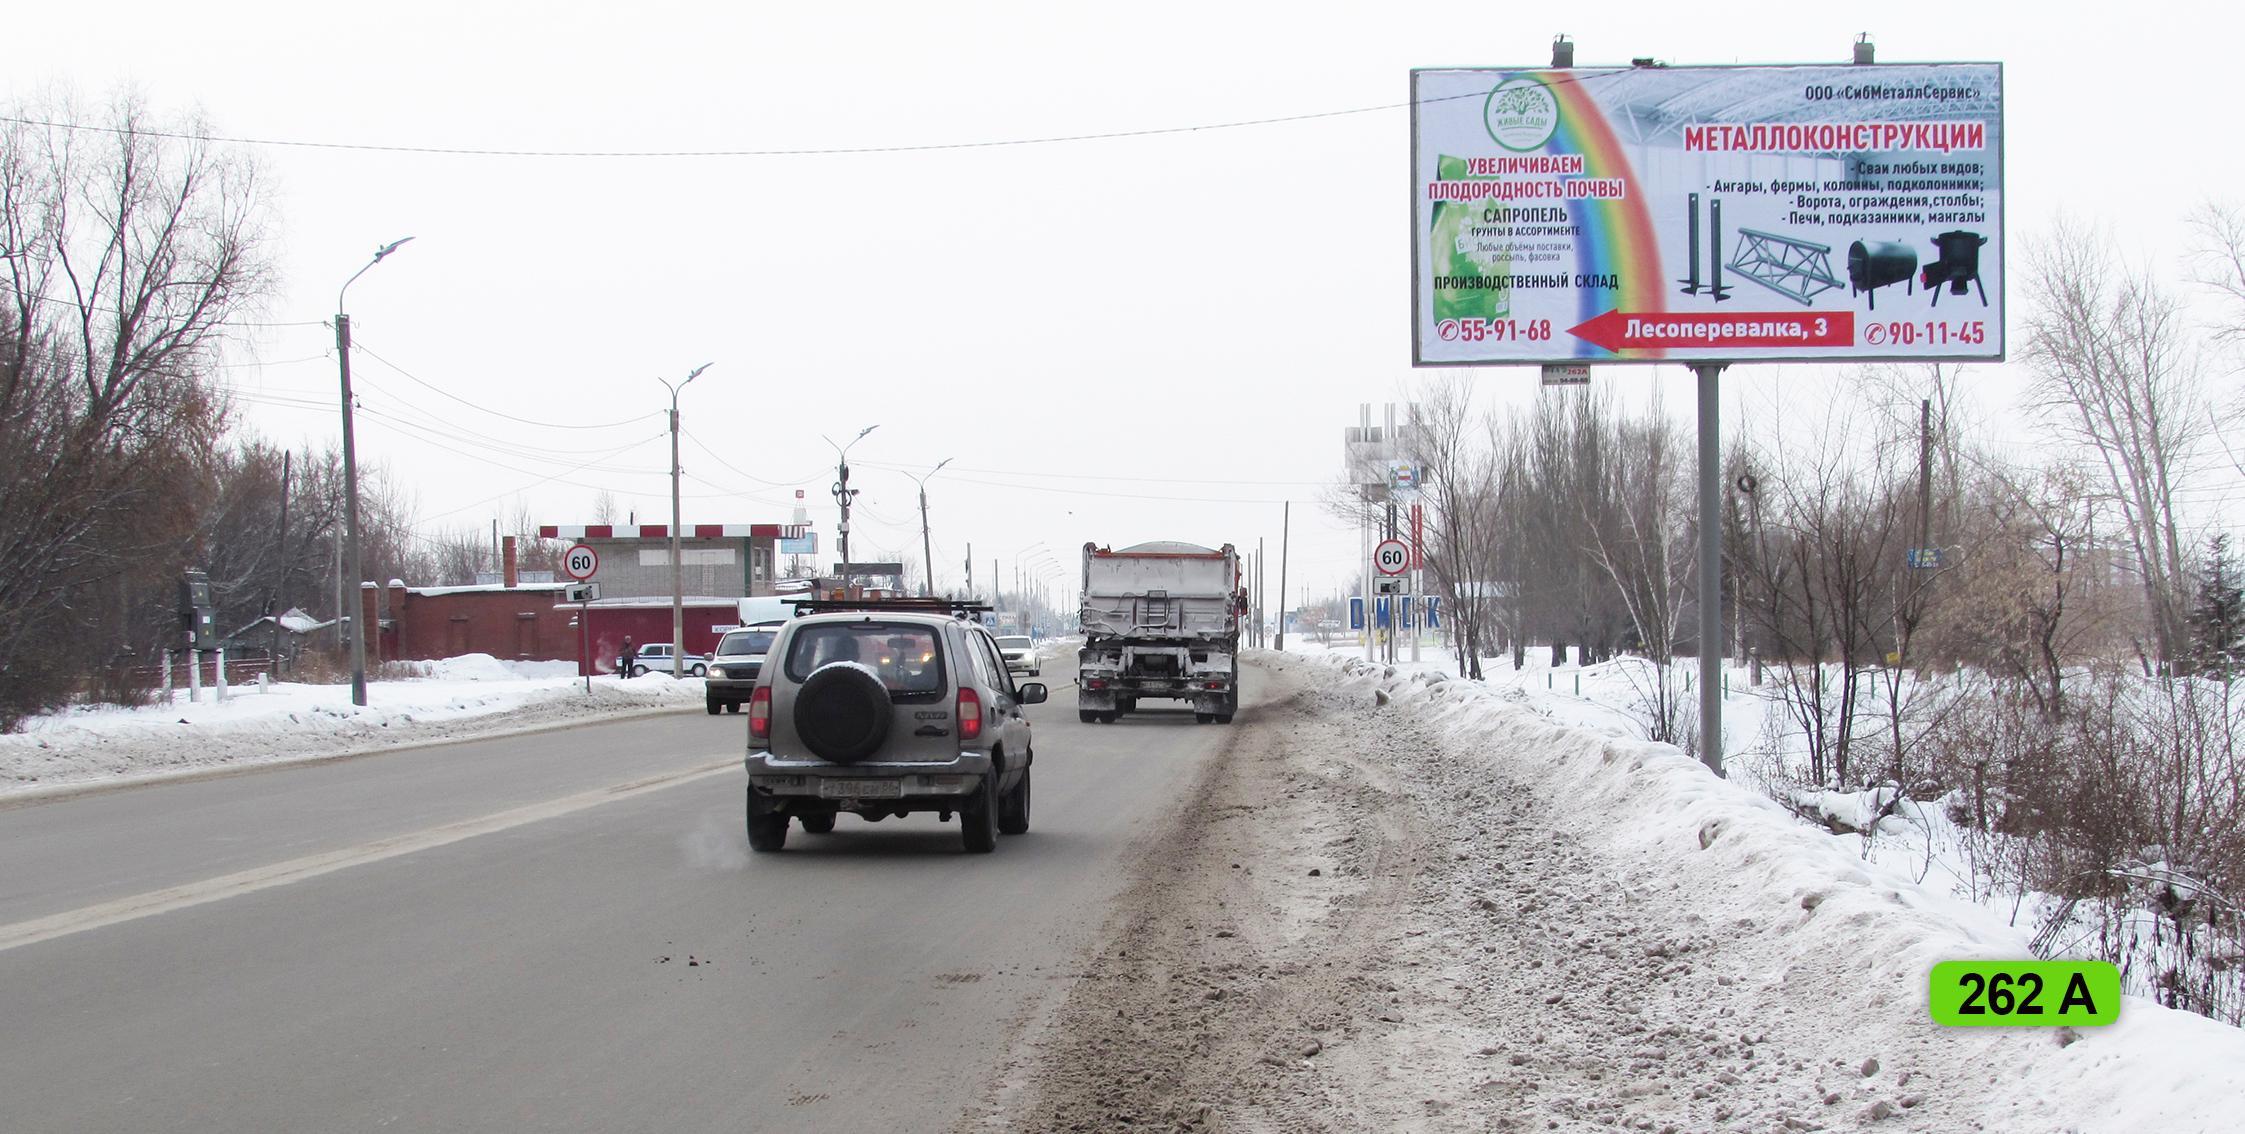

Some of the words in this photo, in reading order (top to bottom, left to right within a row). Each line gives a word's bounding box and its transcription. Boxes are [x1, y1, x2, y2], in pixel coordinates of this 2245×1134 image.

[1805, 86, 1833, 101] ООО
[1836, 85, 1981, 101] «СибМеталлСервис»
[1525, 116, 1548, 127] САДЫ
[1685, 123, 1984, 153] МЕТАЛЛОКОНСТРУКЦИИ
[1468, 156, 1582, 175] УВЕЛИЧИВАЕМ
[1858, 162, 1890, 175] Сваи
[1892, 162, 1938, 175] любых
[1940, 162, 1985, 176] видов;
[1428, 181, 1563, 201] ПЛОДОРОДНОСТЬ
[1567, 180, 1623, 198] ПОЧВЫ
[1714, 180, 1767, 194] Ангары,
[1770, 179, 1820, 194] фермы,
[1824, 180, 1884, 194] колонны,
[1887, 179, 1985, 193] подколонники;
[1797, 196, 1846, 209] Ворота,
[1483, 207, 1568, 224] САПРОПЕЛЬ
[1790, 212, 1825, 226] Печи,
[1828, 211, 1925, 226] подказанники,
[1928, 211, 1985, 224] мангалы
[1471, 227, 1506, 237] ГРУНТЫ
[1508, 227, 1513, 236] В
[1515, 226, 1581, 236] АССОРТИМЕНТЕ
[1477, 242, 1504, 252] Любые
[1536, 243, 1574, 252] поставки,
[1528, 252, 1561, 263] фасовка
[1434, 272, 1569, 291] ПРОИЗВОДСТВЕННЫЙ
[1574, 274, 1619, 290] СКЛАД
[1460, 319, 1551, 342] 55-91-68
[1624, 318, 1809, 341] Лесоперевалка,
[1814, 318, 1828, 337] 3
[1889, 321, 1985, 345] 90-11-45
[572, 555, 591, 569] 60
[1382, 550, 1402, 565] 60
